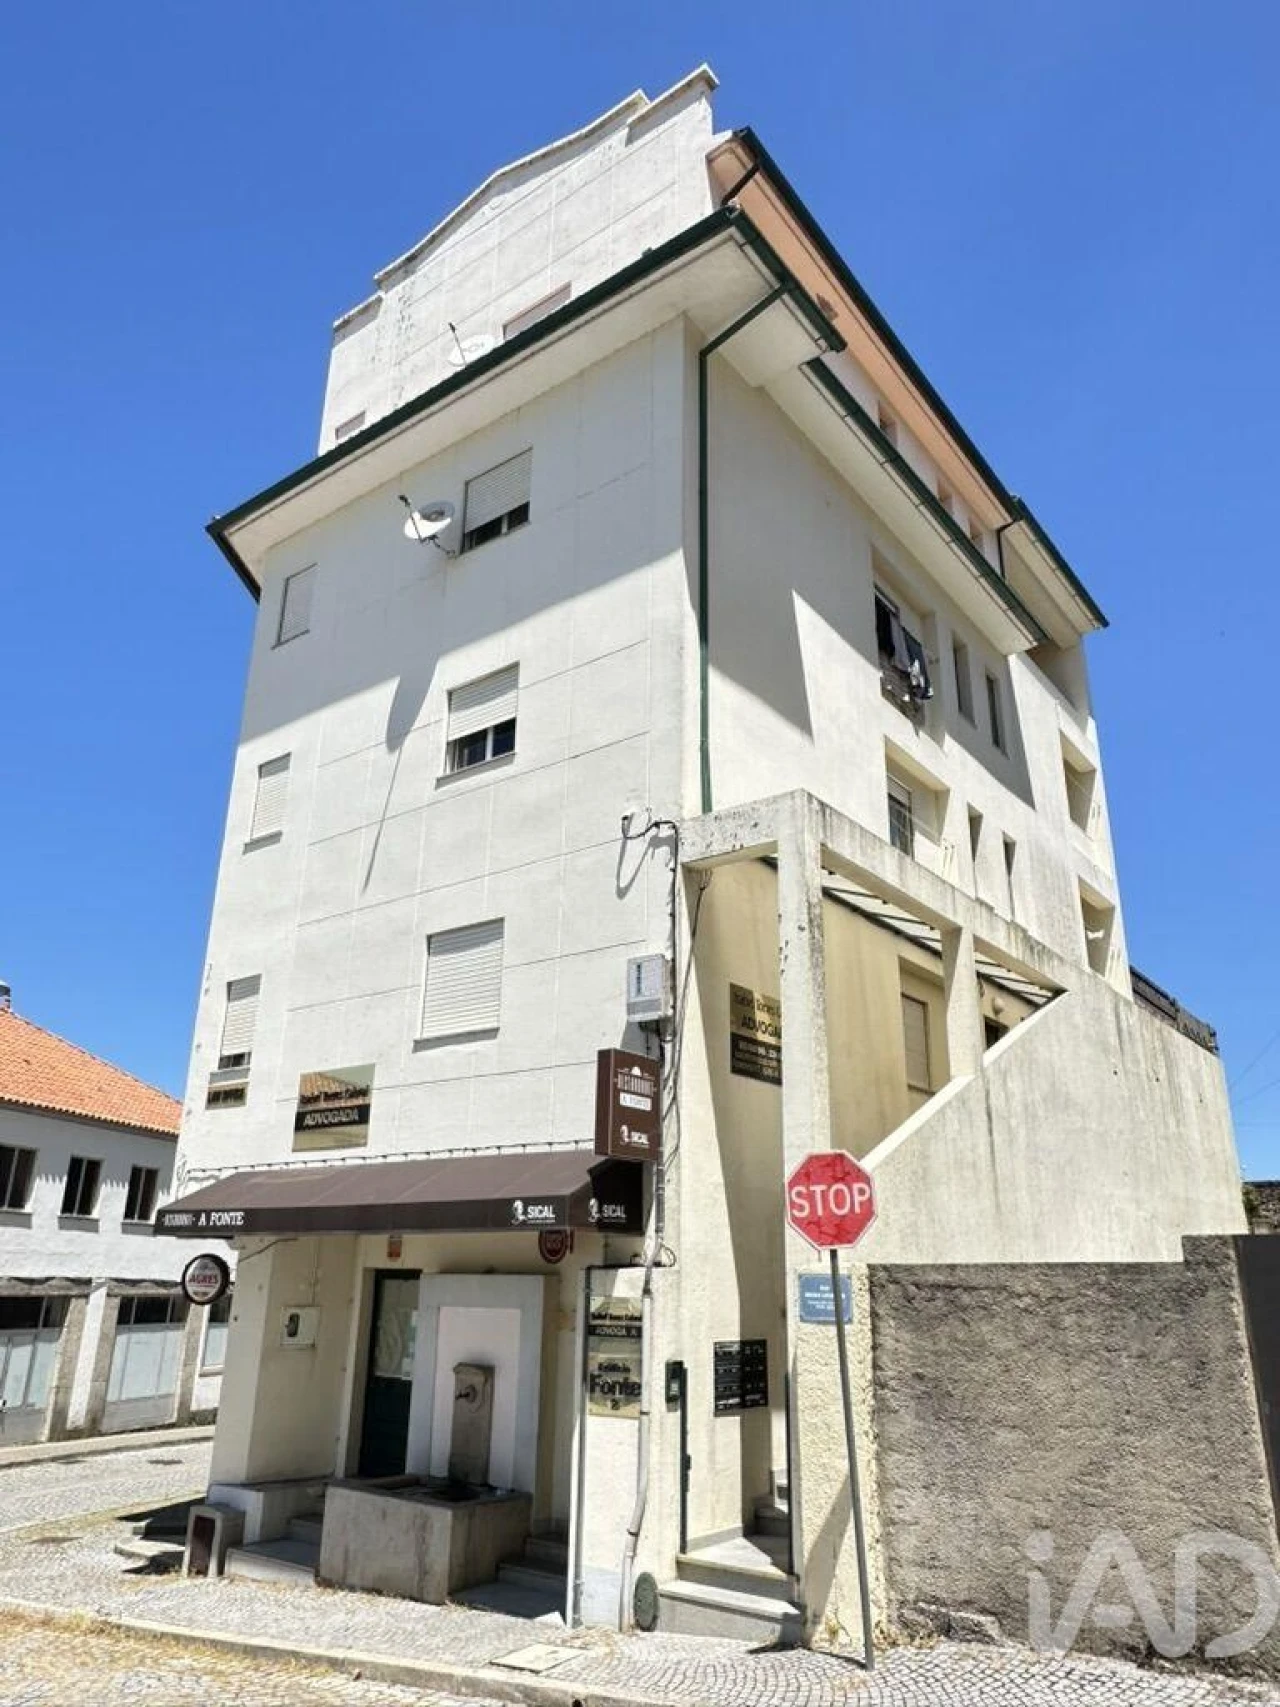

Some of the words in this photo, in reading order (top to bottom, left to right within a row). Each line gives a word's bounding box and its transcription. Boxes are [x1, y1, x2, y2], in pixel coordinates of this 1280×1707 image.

[303, 1107, 359, 1127] ADVOGADA
[790, 1182, 871, 1218] STOP
[198, 1212, 206, 1226] A
[209, 1211, 244, 1226] FONTE
[527, 1204, 556, 1218] SICAL
[602, 1204, 627, 1218] SICAL
[590, 1373, 641, 1396] Fonte
